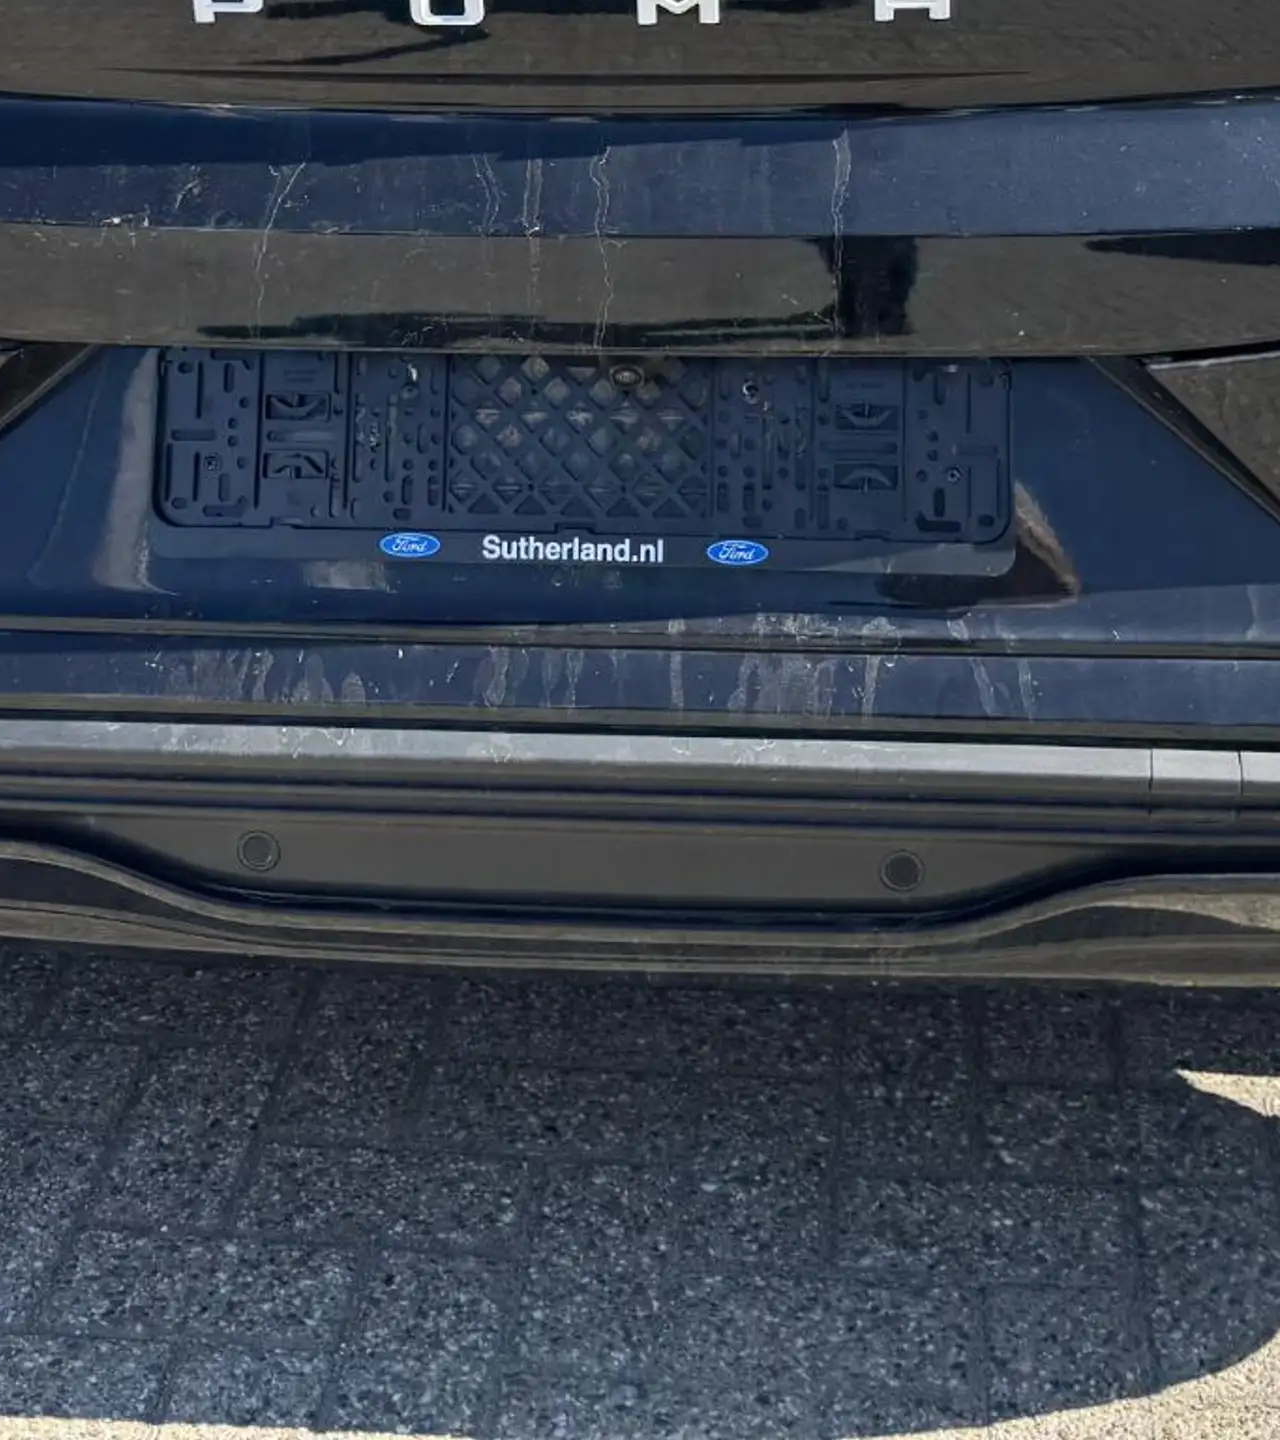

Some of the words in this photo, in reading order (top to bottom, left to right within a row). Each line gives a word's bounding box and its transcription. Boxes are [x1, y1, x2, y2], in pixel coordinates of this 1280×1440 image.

[392, 535, 427, 552] Ford
[482, 534, 664, 563] Sutherland.nl
[719, 542, 756, 560] Ford
